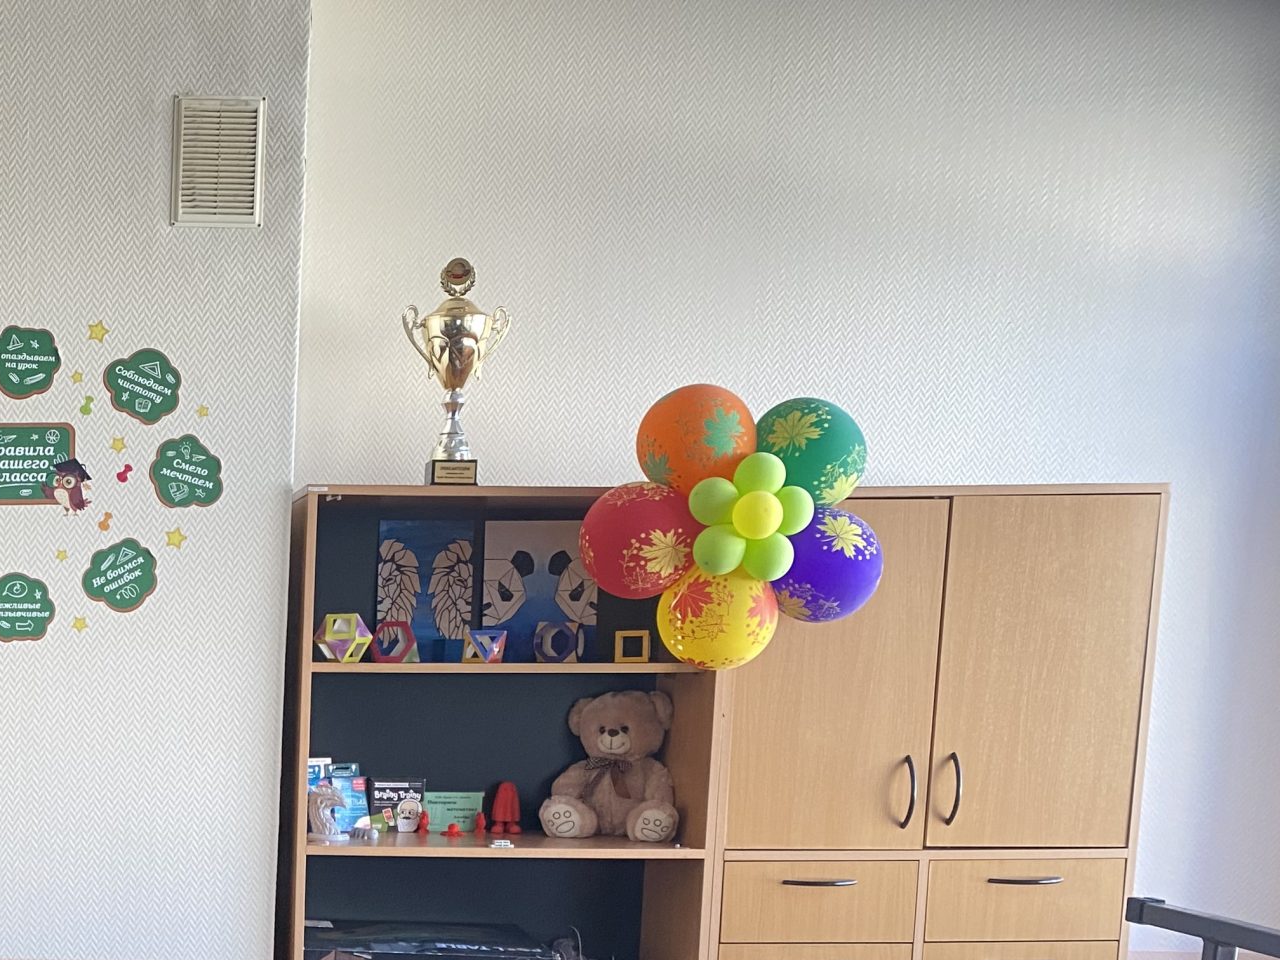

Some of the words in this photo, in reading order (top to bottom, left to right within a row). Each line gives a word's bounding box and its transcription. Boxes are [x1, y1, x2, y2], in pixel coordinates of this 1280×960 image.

[1, 353, 56, 362] опаздываем
[115, 365, 172, 396] Соблюдаем
[117, 378, 163, 404] чистоту
[160, 467, 214, 489] мечтаем
[173, 458, 209, 476] Смело
[91, 575, 107, 588] Не
[106, 556, 145, 580] боимся
[103, 568, 143, 593] ошибок
[374, 789, 398, 801] Brainy
[398, 789, 422, 802] Trainy
